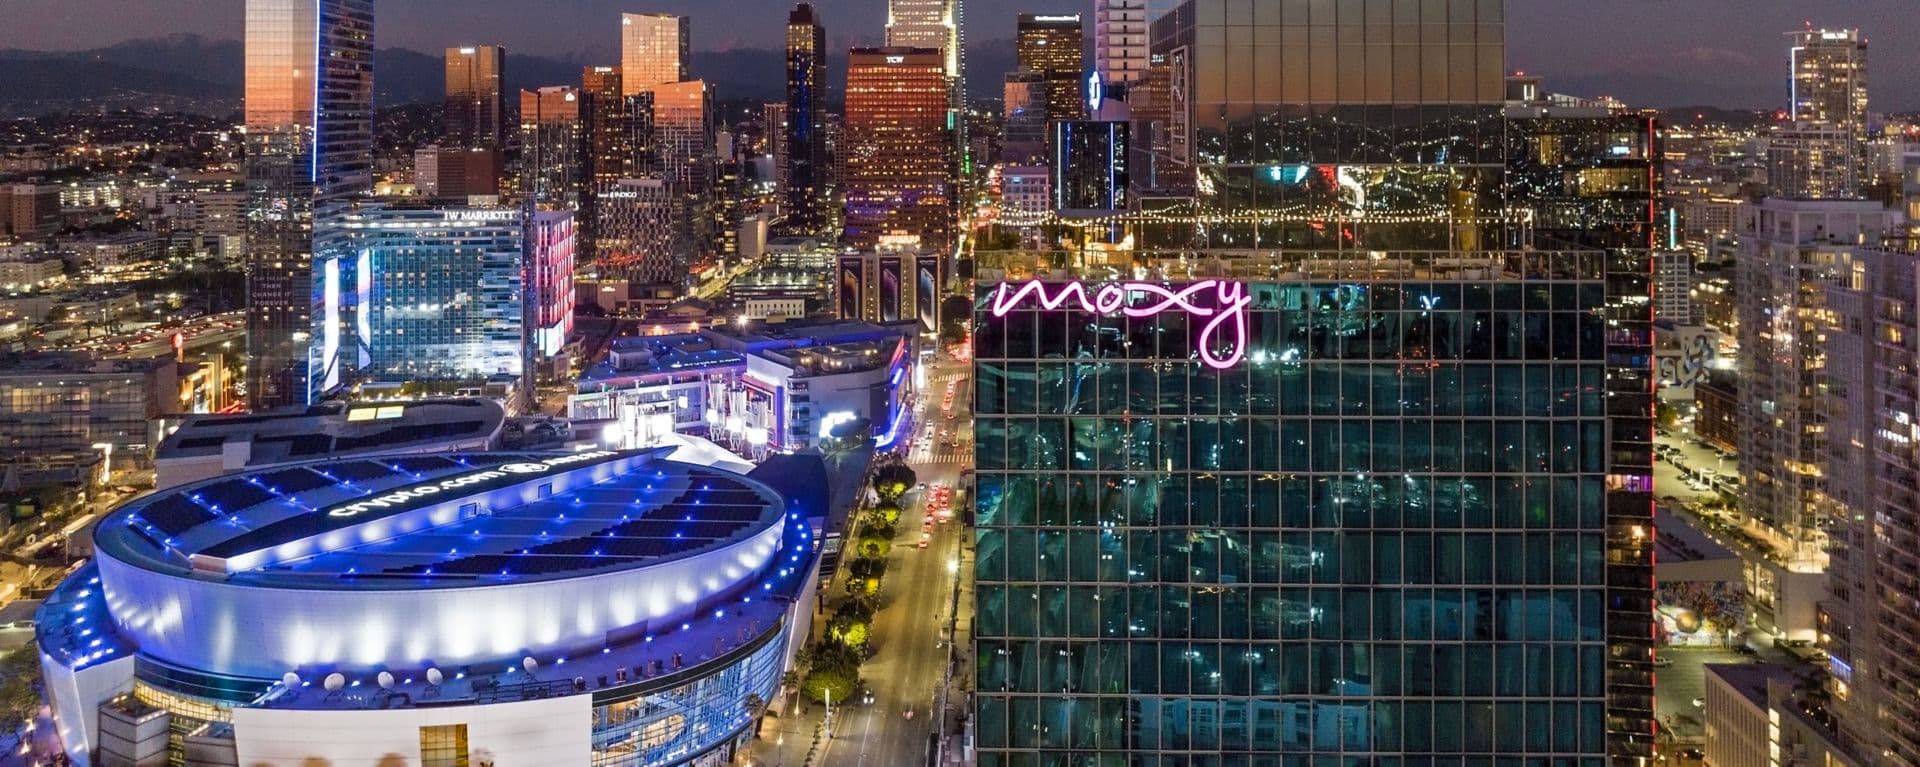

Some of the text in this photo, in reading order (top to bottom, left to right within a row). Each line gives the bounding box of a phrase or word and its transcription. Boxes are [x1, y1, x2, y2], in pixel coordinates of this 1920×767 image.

[886, 56, 904, 64] TCW
[444, 210, 515, 221] JW MARRIOTT
[992, 279, 1252, 369] moxy
[328, 470, 508, 517] crypto.com
